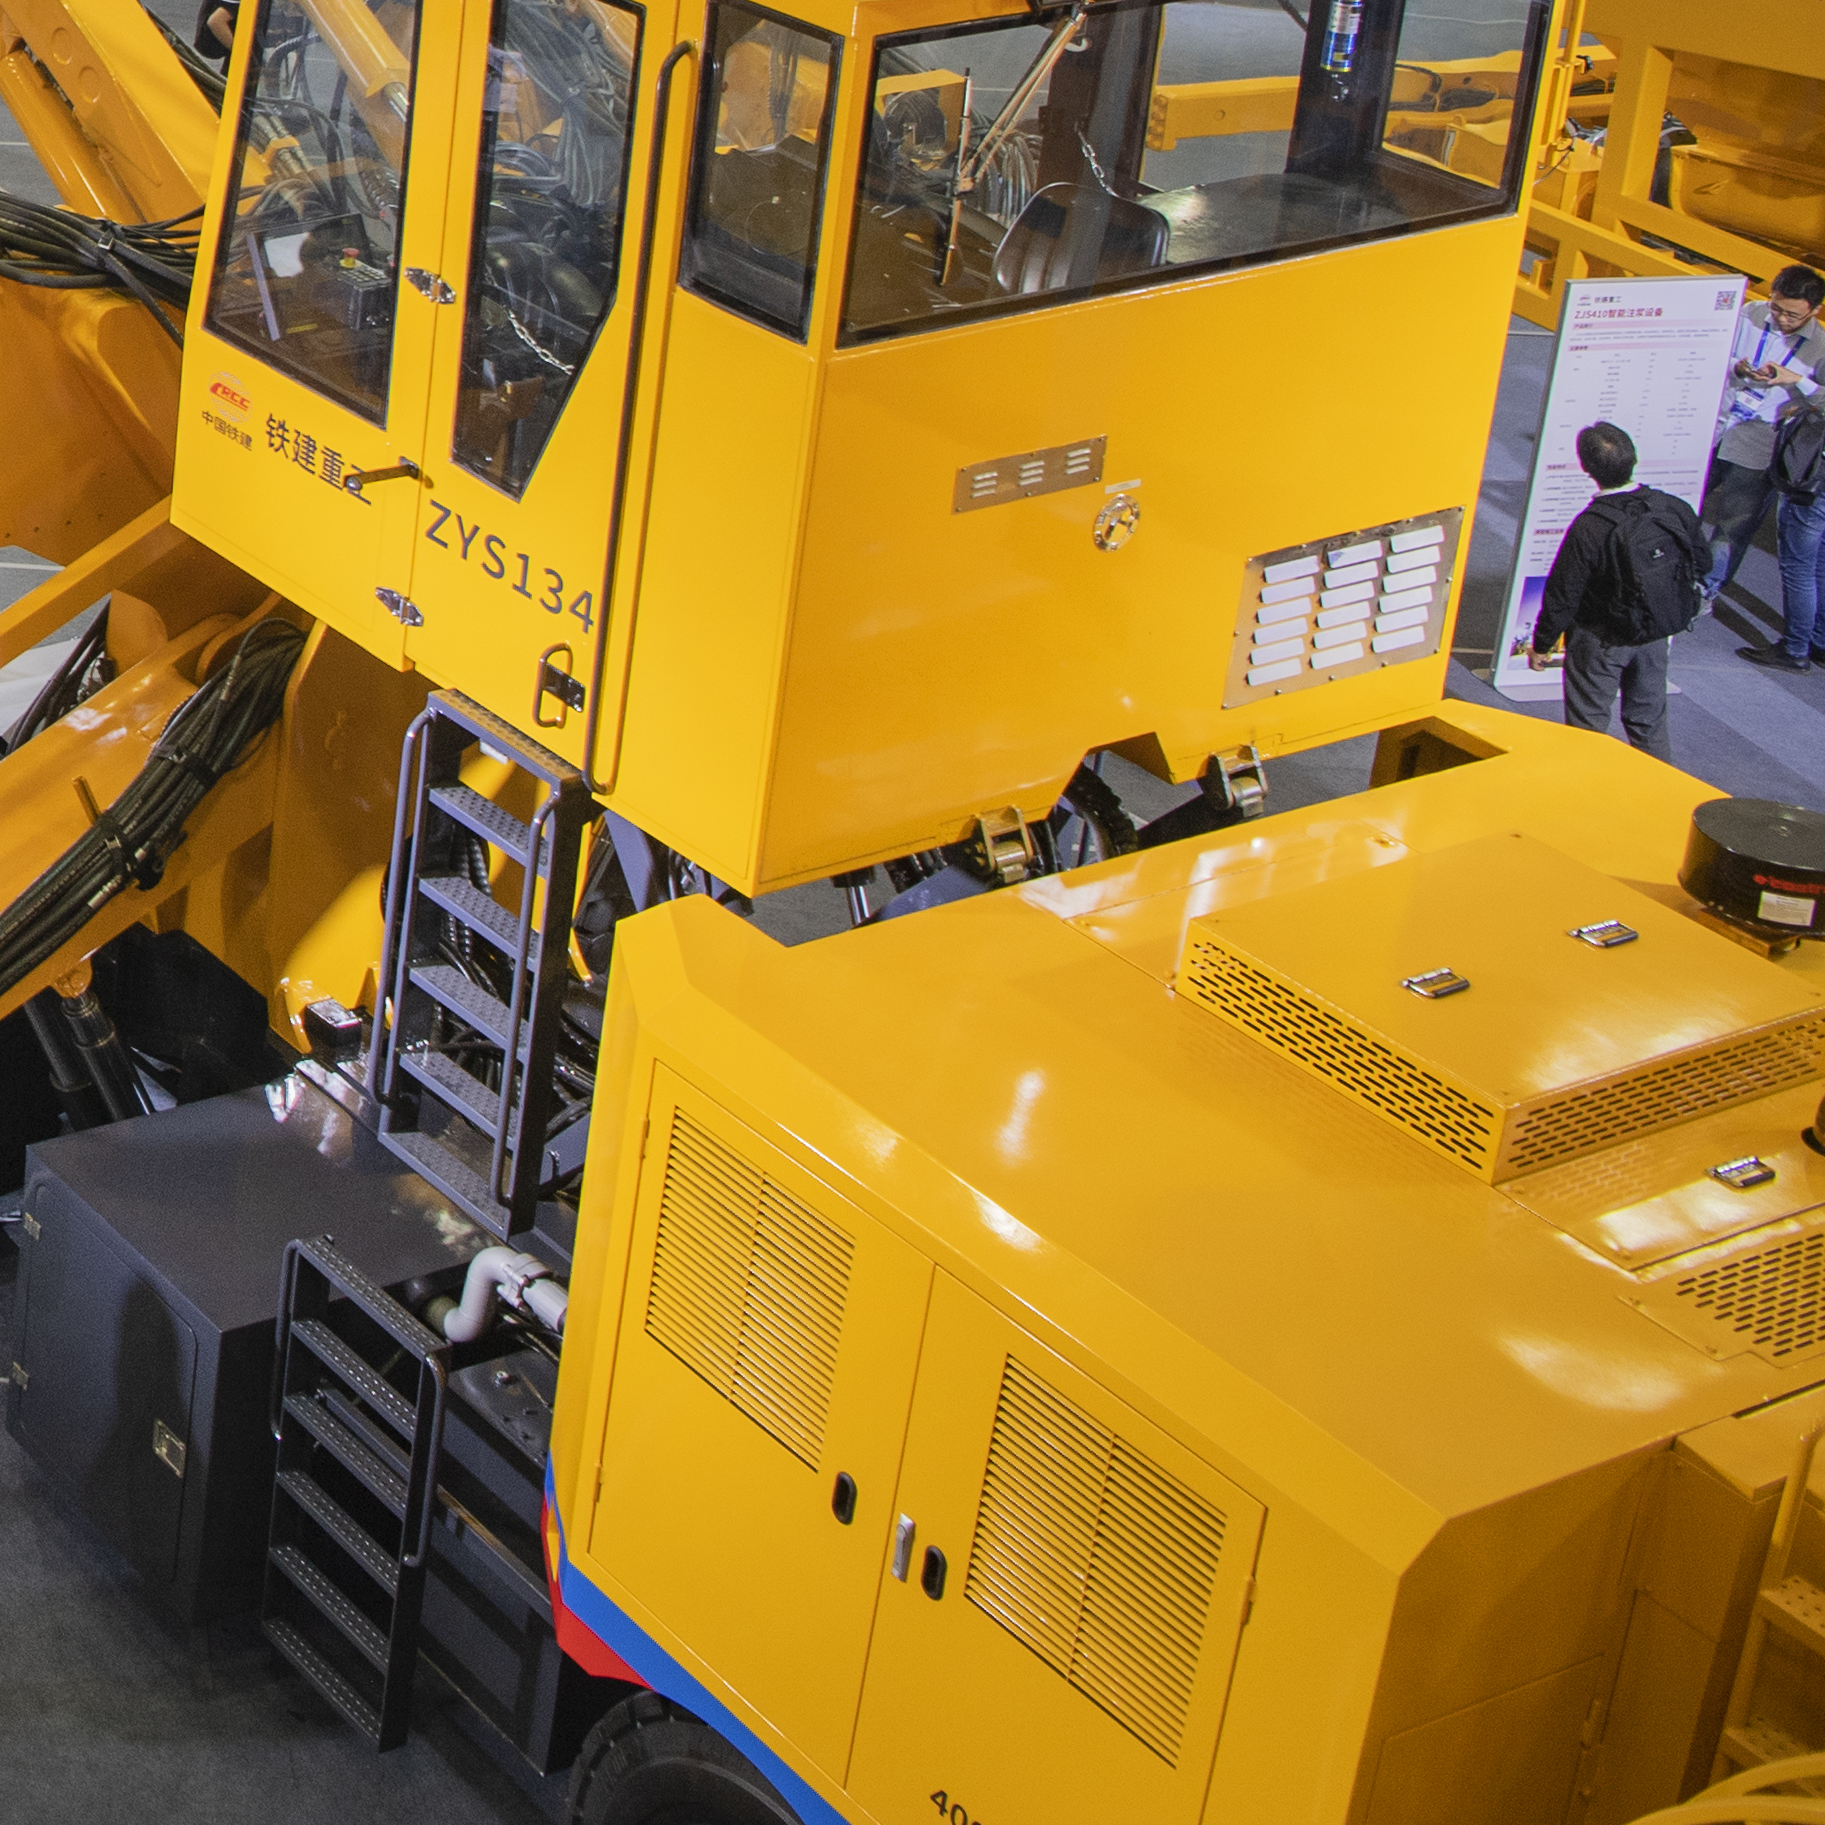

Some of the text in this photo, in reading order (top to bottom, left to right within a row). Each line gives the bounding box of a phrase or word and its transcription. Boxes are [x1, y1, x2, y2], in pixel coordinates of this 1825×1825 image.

[209, 381, 250, 412] CRCC
[201, 410, 254, 452] 中国铁建
[425, 499, 594, 635] ZYS134
[930, 1790, 982, 1825] 40
